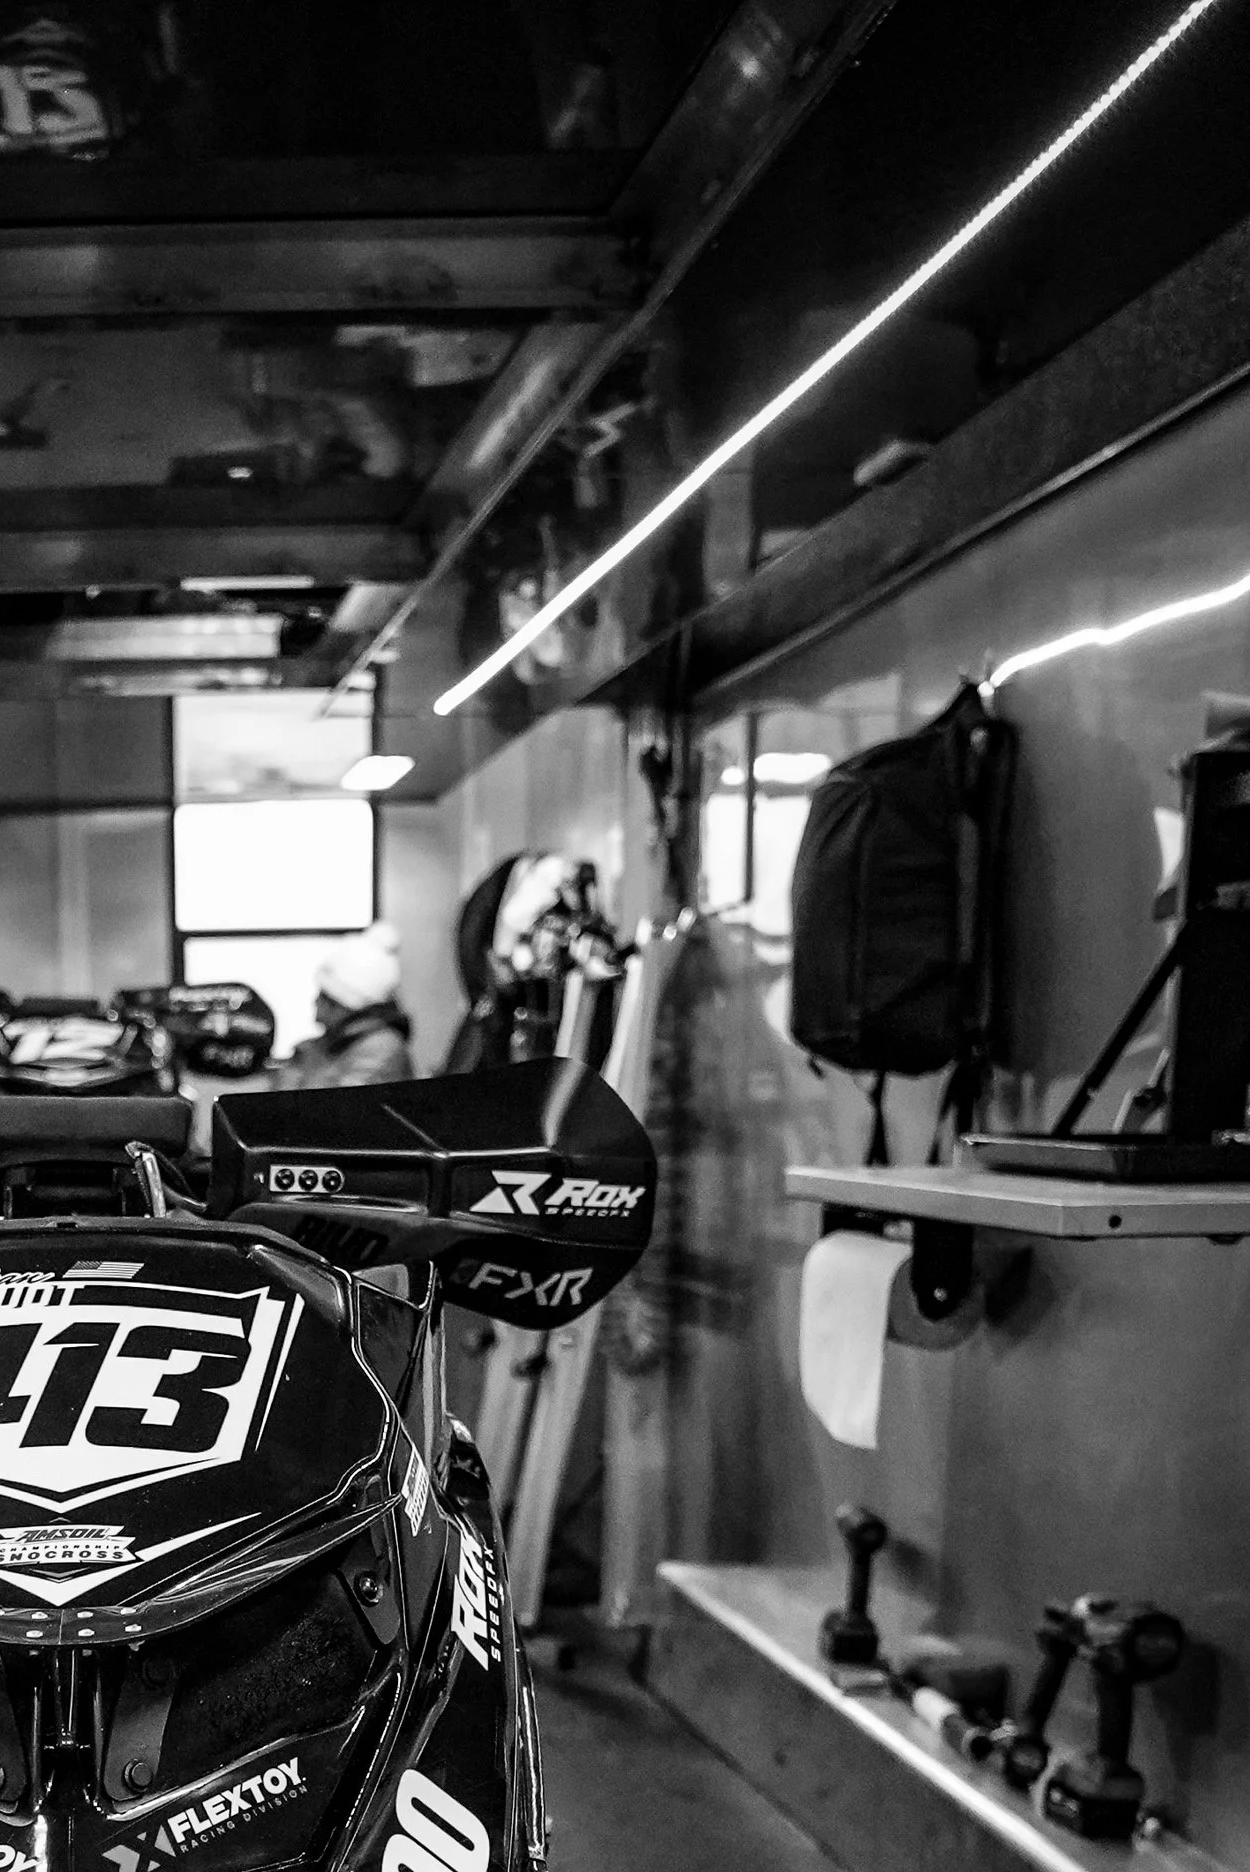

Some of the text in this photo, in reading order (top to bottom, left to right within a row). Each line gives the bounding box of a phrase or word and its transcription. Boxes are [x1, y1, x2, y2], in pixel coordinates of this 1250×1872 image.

[544, 1177, 648, 1210] ROX
[467, 1261, 595, 1308] FXR
[15, 1527, 110, 1543] AMSOIL
[450, 1532, 489, 1672] ROX
[483, 1548, 502, 1663] SPEEDFX
[180, 1784, 308, 1854] RACING DIVISION
